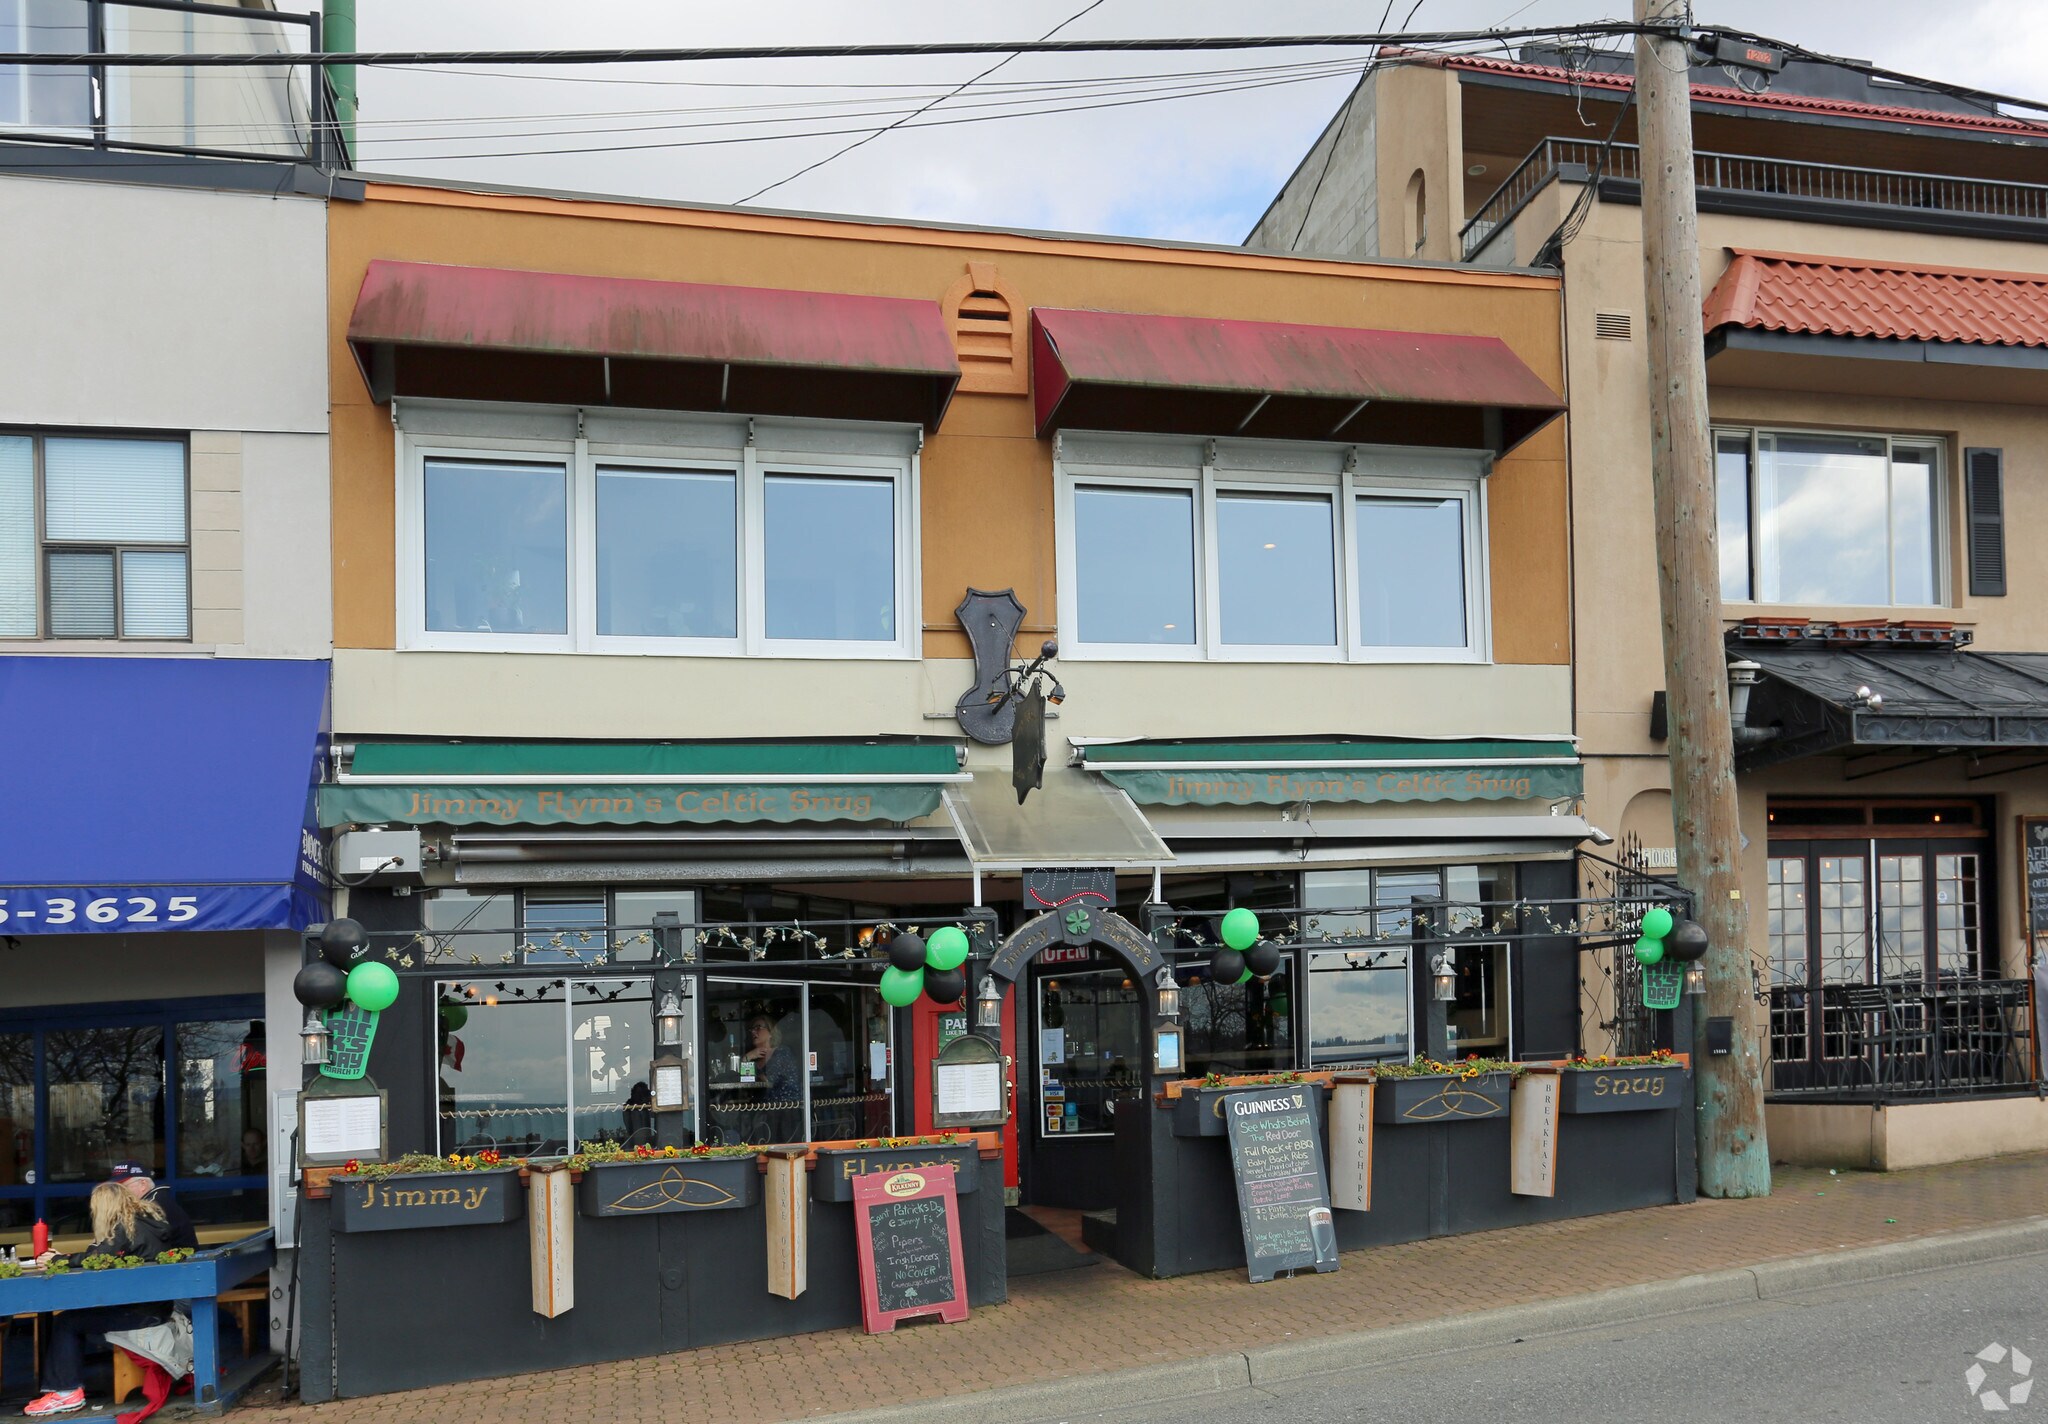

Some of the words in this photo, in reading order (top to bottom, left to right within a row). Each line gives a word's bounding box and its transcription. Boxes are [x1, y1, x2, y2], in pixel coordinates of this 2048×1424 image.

[1747, 49, 1771, 64] 1202
[1167, 776, 1256, 801] Jimmy
[1266, 775, 1367, 797] Flynn's
[1375, 773, 1457, 794] Celtic
[1465, 773, 1531, 797] Snug
[405, 792, 523, 820] Jimmy
[537, 790, 662, 819] Flynn's
[675, 790, 777, 814] Celtic
[788, 790, 873, 817] Snug
[1029, 867, 1111, 891] OPEN
[350, 939, 371, 960] GUINN
[1003, 927, 1049, 970] Jimmy
[1043, 946, 1088, 961] OPEN
[327, 1050, 364, 1070] DAY
[323, 1065, 351, 1075] MARCH
[1594, 1075, 1665, 1097] Snug
[1234, 1097, 1290, 1116] GUINNESS
[1358, 1089, 1366, 1132] FISH
[1240, 1121, 1259, 1134] See
[1265, 1131, 1281, 1141] Red
[1281, 1129, 1301, 1140] Door
[1541, 1084, 1552, 1181] BREAKFAST
[1244, 1146, 1259, 1157] Full
[1261, 1144, 1284, 1155] Rack
[1293, 1140, 1314, 1151] BBQ
[1357, 1137, 1364, 1145] &
[1247, 1158, 1267, 1168] Baby
[1268, 1154, 1290, 1164] Back
[1291, 1151, 1309, 1160] Ribs
[1357, 1149, 1365, 1204] CHIPS
[890, 1180, 920, 1192] KILKENNY
[362, 1183, 489, 1210] Jimmy
[930, 1200, 946, 1218] Day
[891, 1234, 924, 1249] Pipers
[886, 1256, 911, 1266] Irish
[910, 1252, 940, 1263] Dancers
[895, 1270, 907, 1280] NO
[907, 1265, 936, 1279] COVER
